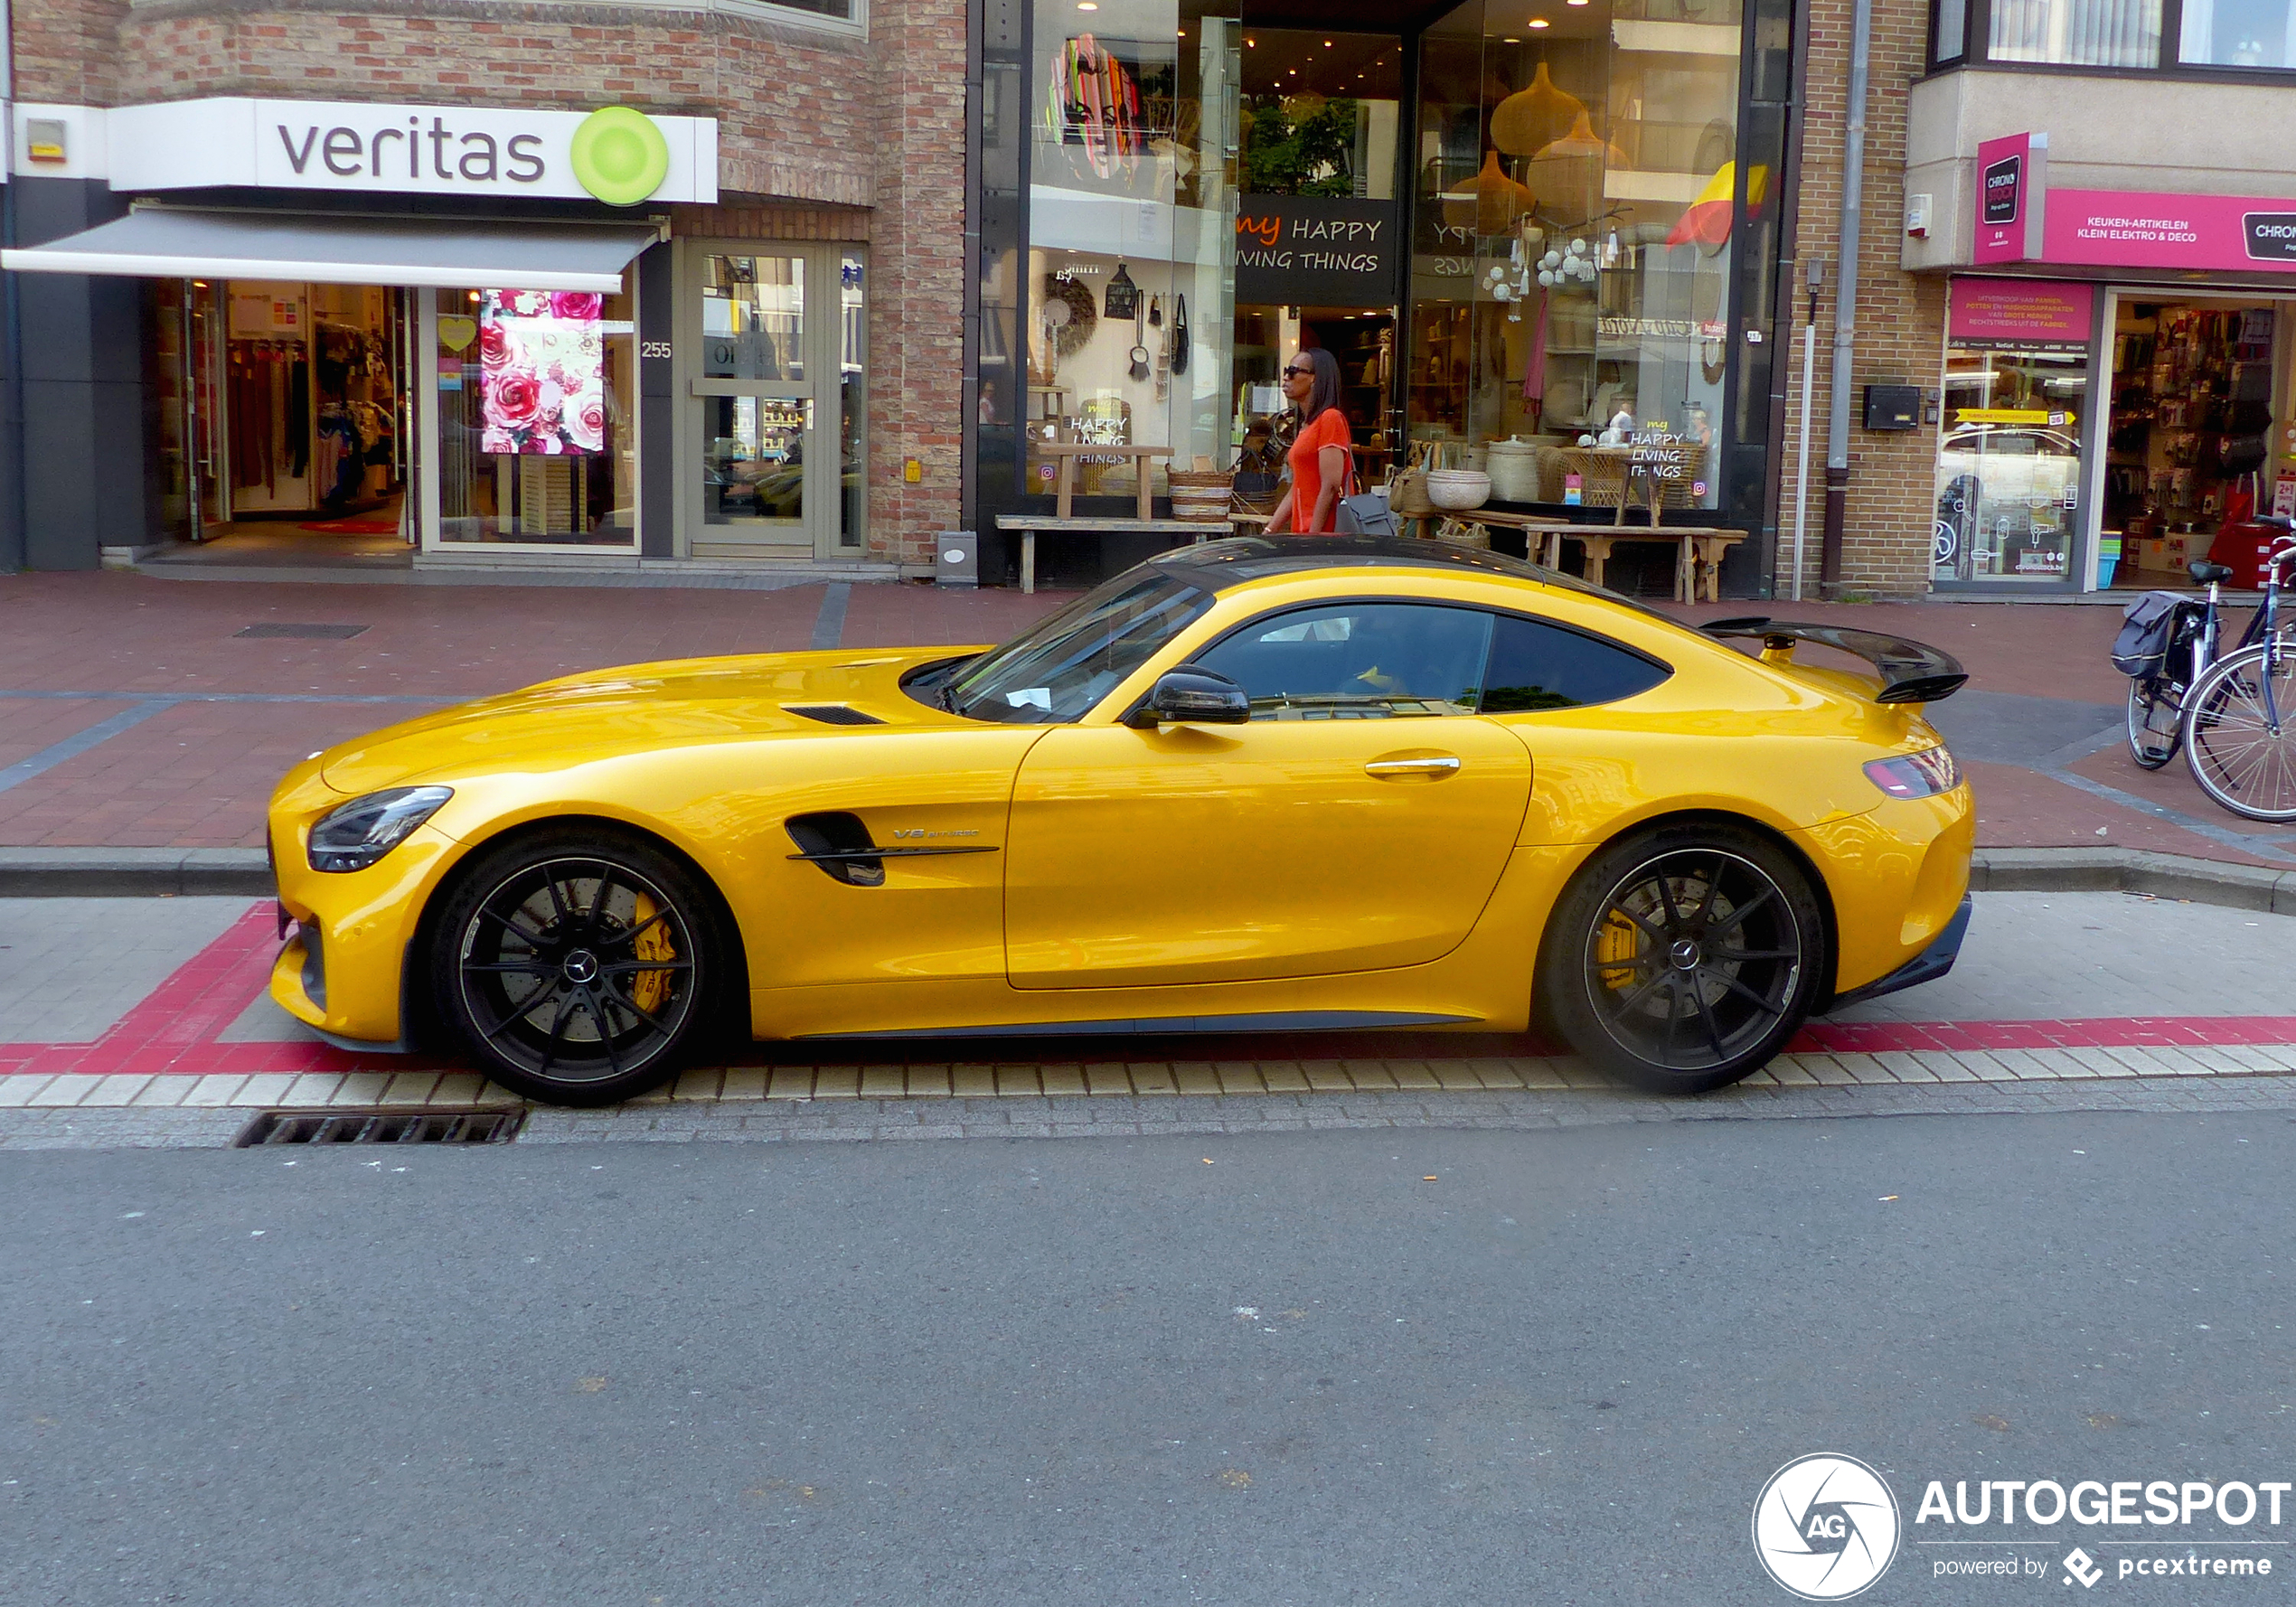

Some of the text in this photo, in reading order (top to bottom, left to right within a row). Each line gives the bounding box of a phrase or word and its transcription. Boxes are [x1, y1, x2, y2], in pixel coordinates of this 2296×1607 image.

[277, 115, 545, 183] veritas
[2087, 216, 2188, 230] KEUKEN-ARTIKELEN
[1292, 219, 1382, 242] HAPPY
[2077, 229, 2197, 242] KLEIN ELEKTRO & DECO
[1236, 249, 1379, 272] IVING THINGS
[642, 342, 672, 359] 255
[1070, 417, 1128, 432] HAPPY
[1646, 420, 1670, 432] my
[1631, 432, 1683, 446] HAPPY
[1632, 449, 1680, 462] LIVING
[1631, 465, 1682, 478] THNGS
[894, 829, 925, 839] V8
